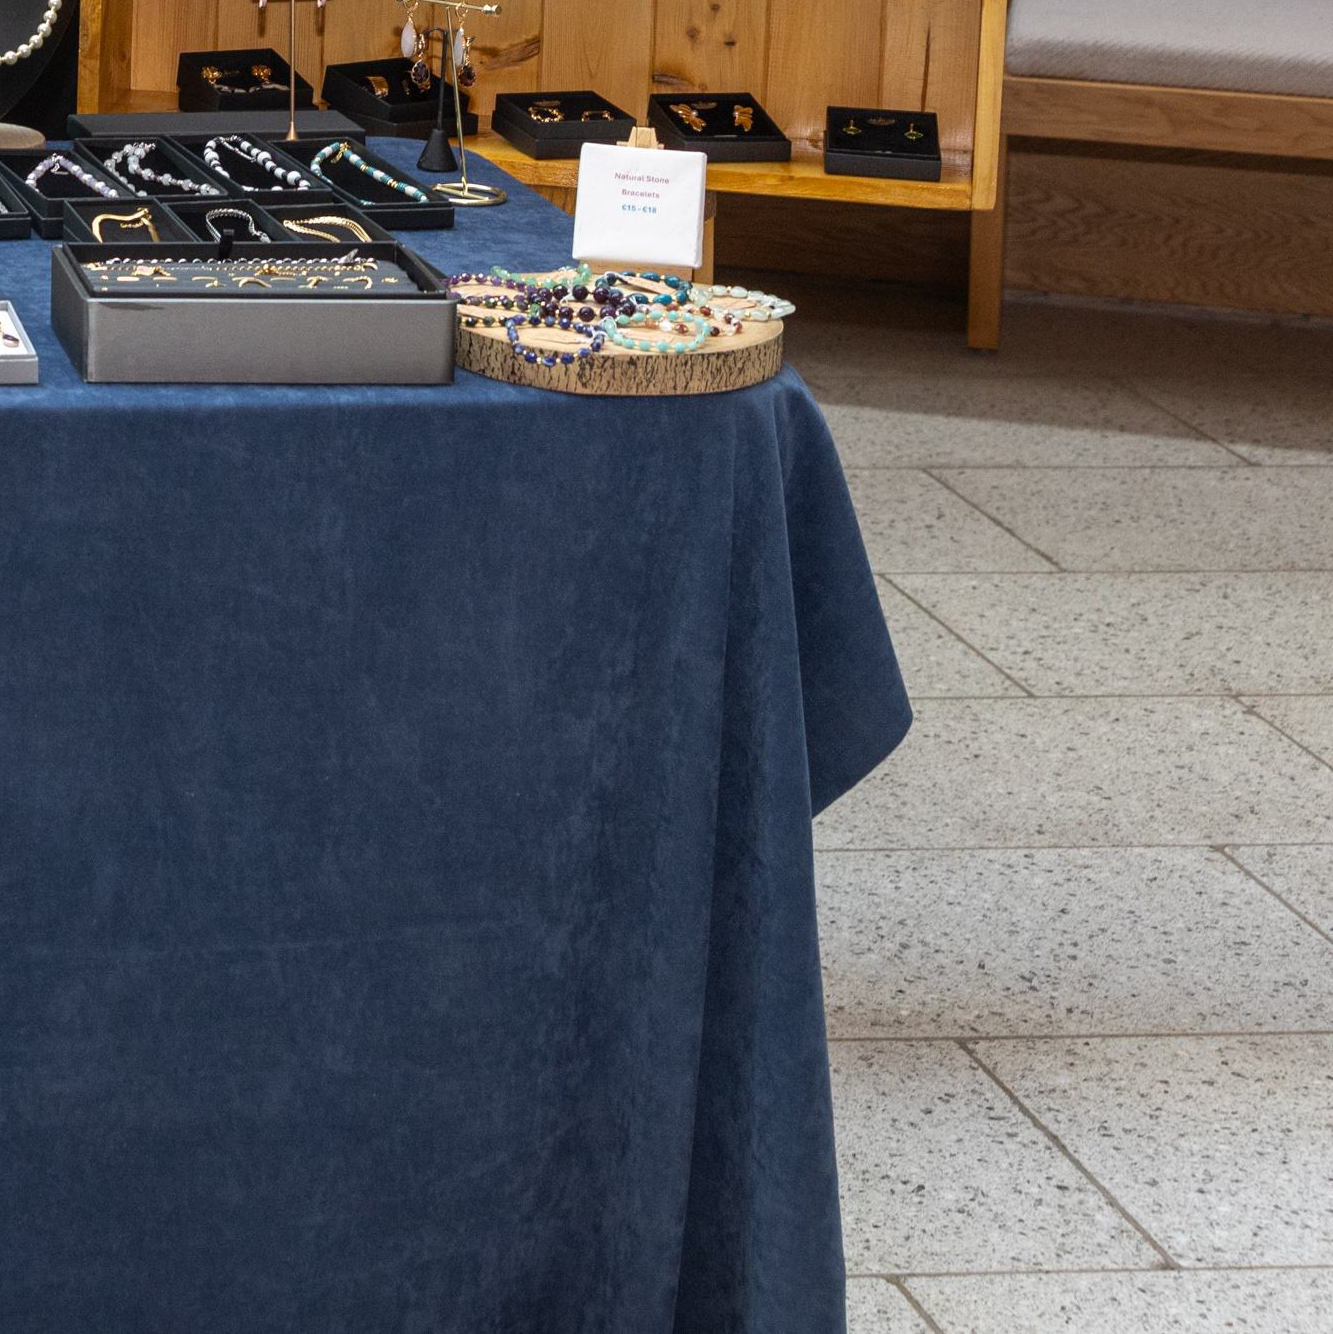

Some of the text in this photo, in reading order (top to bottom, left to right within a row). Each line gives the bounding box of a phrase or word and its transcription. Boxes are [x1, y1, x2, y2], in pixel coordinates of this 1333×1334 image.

[615, 172, 670, 184] Natural Stone
[621, 188, 660, 199] Bracelets
[621, 204, 636, 212] €15
[642, 206, 657, 214] €18
